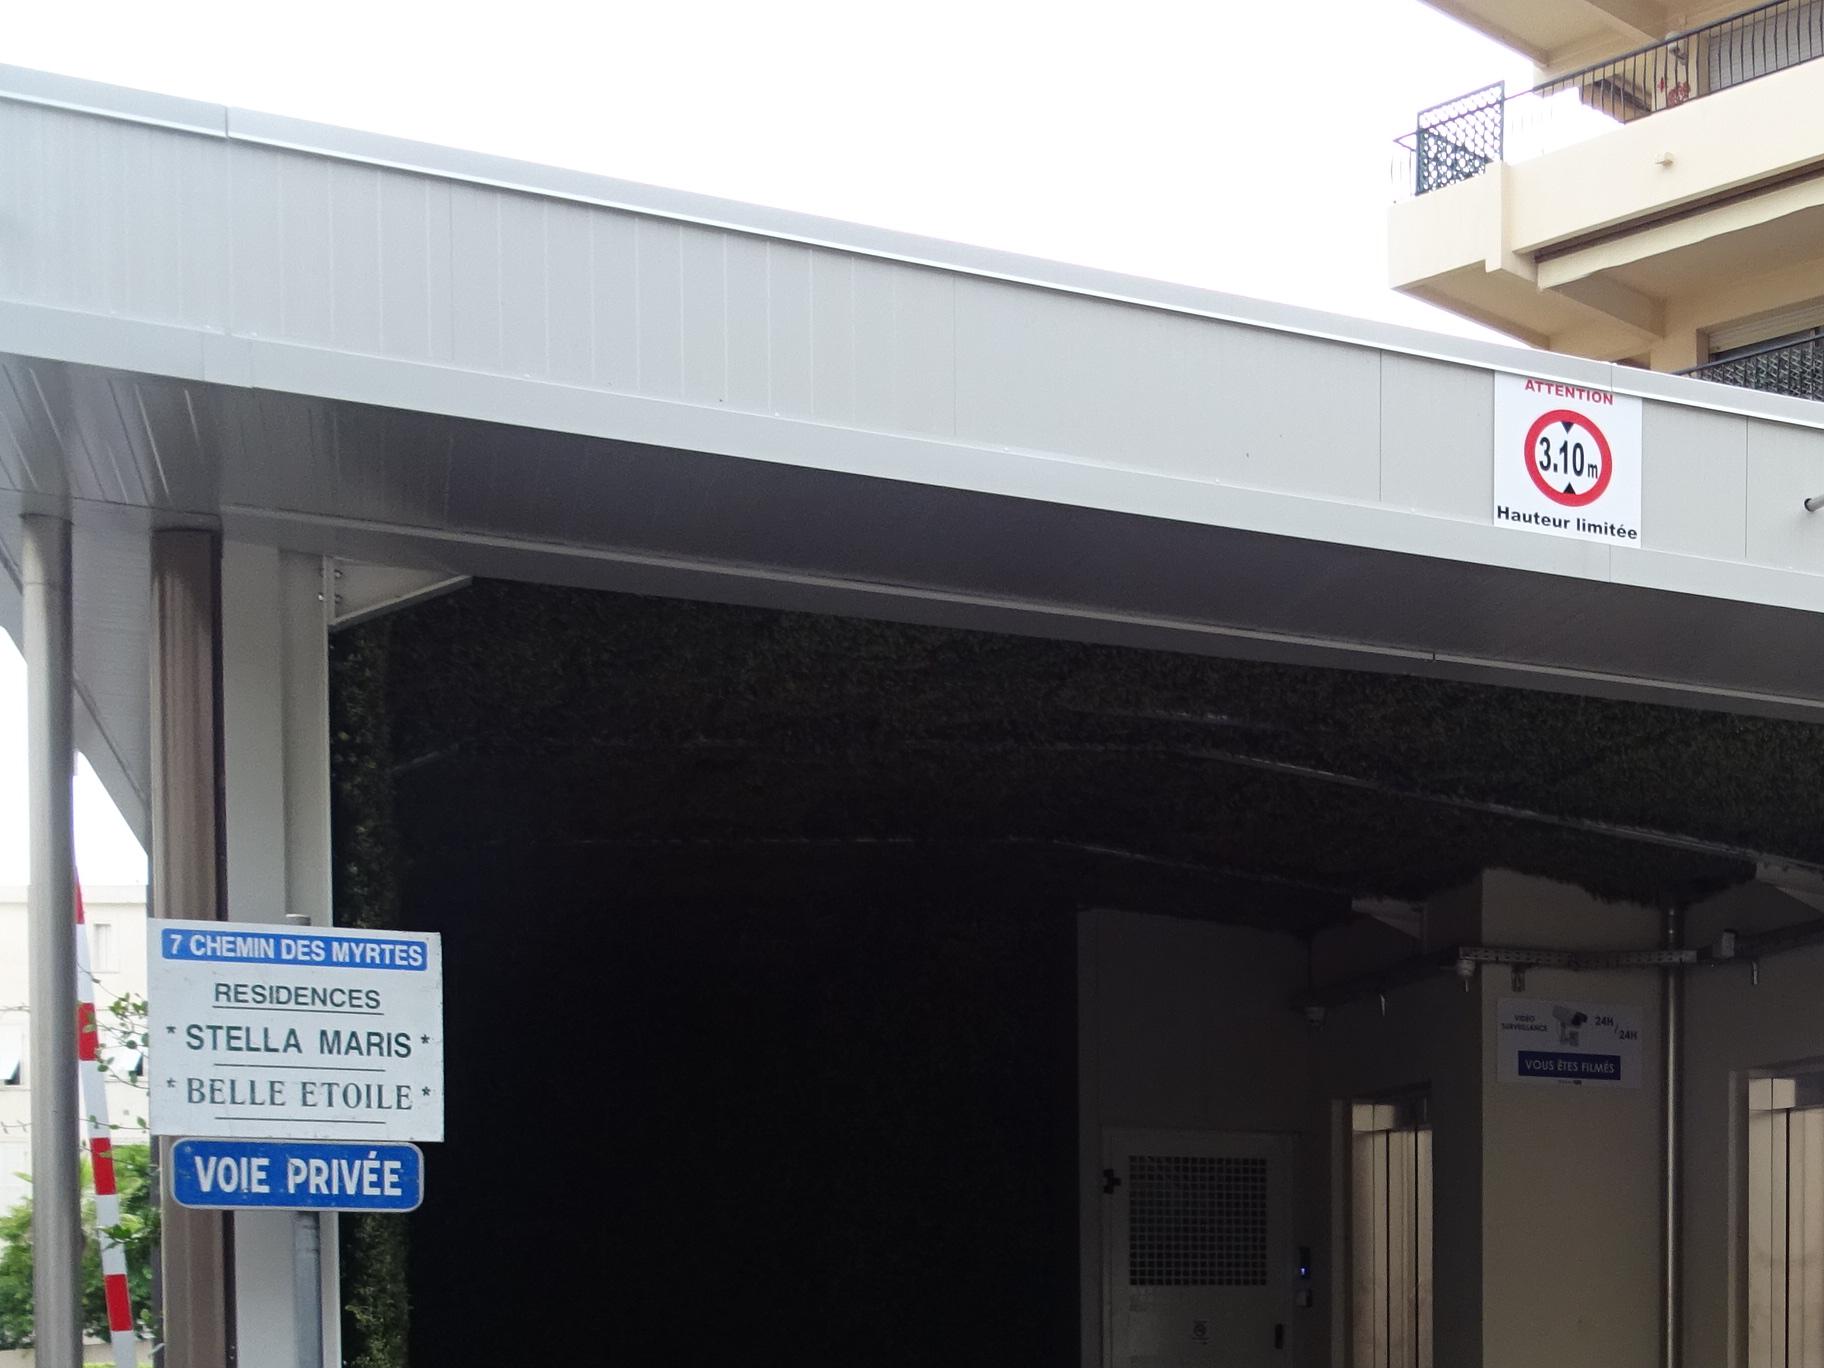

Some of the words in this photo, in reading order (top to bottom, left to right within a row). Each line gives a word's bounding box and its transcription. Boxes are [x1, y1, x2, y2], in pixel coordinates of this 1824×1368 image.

[1525, 379, 1613, 405] ATTENTION
[1539, 437, 1584, 477] 3.10
[1587, 463, 1598, 479] m
[1497, 506, 1570, 529] Hauteur
[1576, 518, 1638, 540] limitée
[170, 934, 182, 955] 7
[190, 935, 274, 959] CHEMIN
[281, 938, 325, 962] DES
[332, 941, 423, 967] MYRTES
[215, 983, 381, 1009] RESIDENCES
[186, 1024, 302, 1054] STELLA
[320, 1030, 412, 1059] MARIS
[1502, 1023, 1548, 1032] SURVEILLANCE
[1525, 1060, 1554, 1071] VOUS
[1558, 1058, 1578, 1072] ÊTES
[1581, 1061, 1615, 1074] FILMÉS
[187, 1078, 285, 1106] BELLE
[300, 1082, 413, 1110] ETOILE
[195, 1156, 270, 1193] VOIE
[287, 1151, 402, 1196] PRIVÉE
